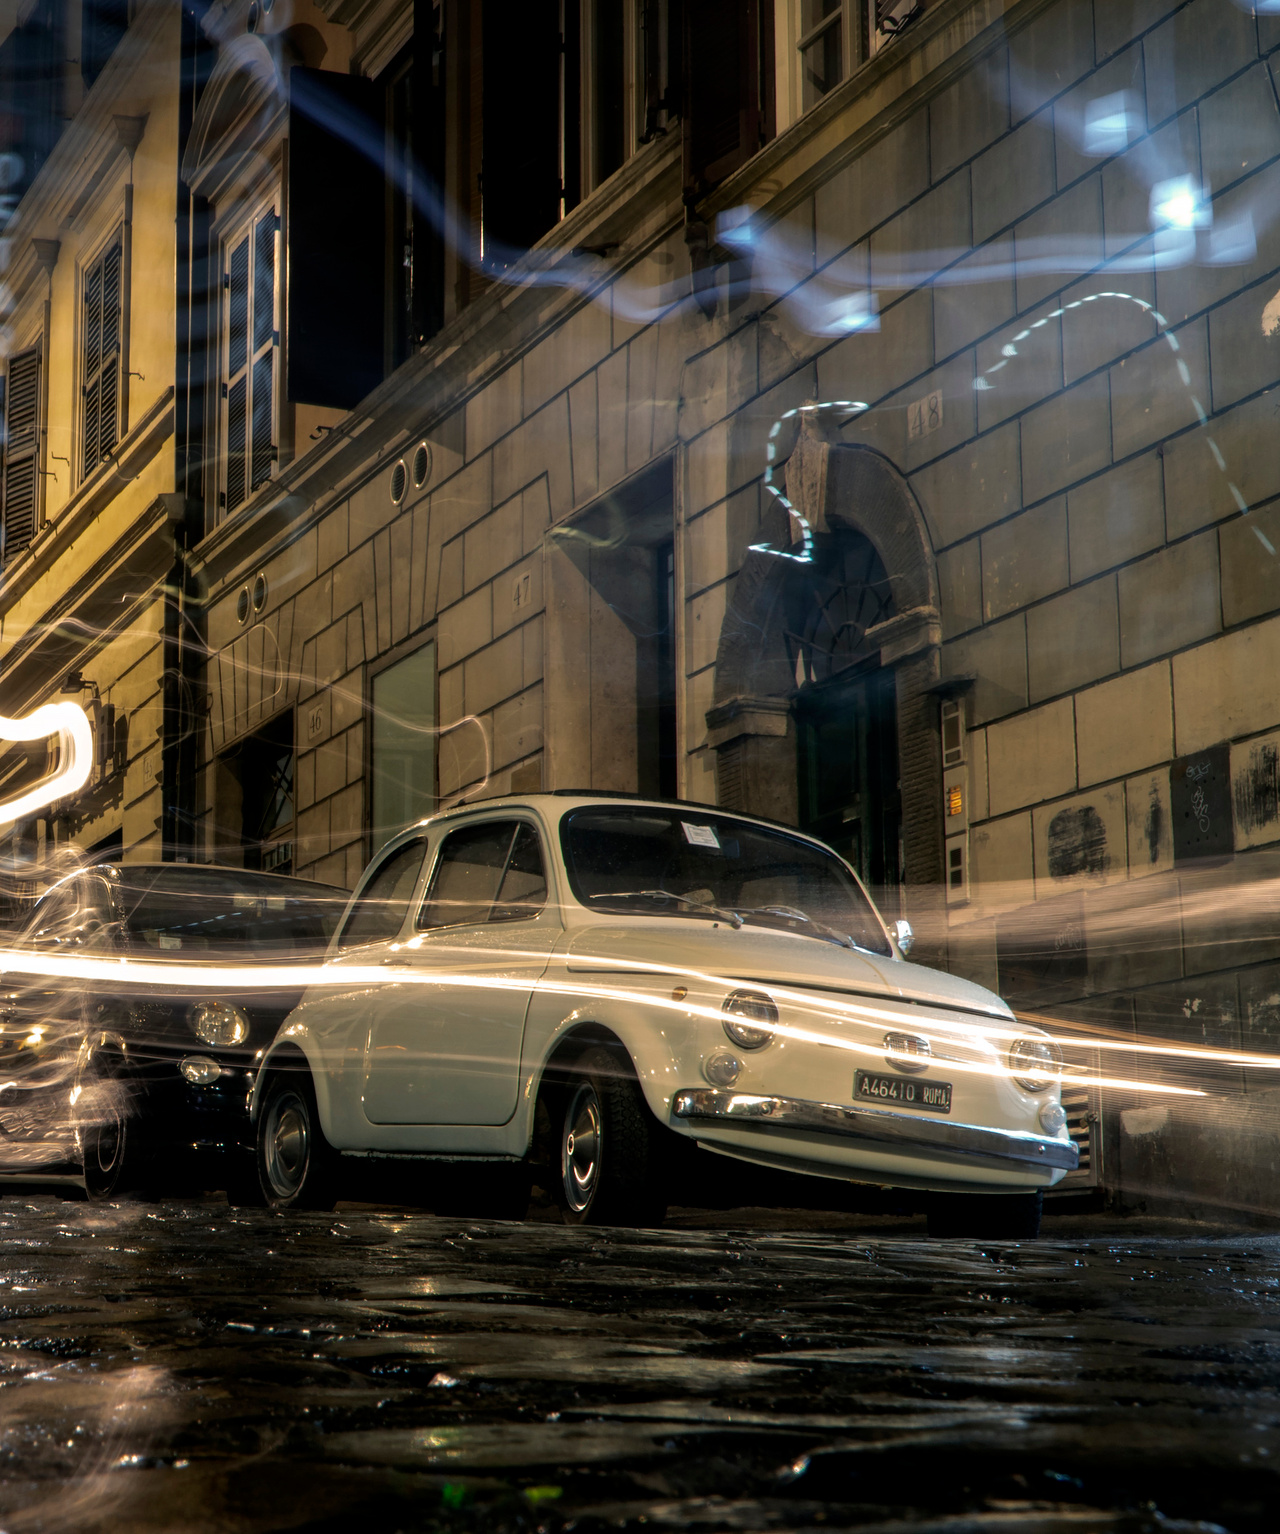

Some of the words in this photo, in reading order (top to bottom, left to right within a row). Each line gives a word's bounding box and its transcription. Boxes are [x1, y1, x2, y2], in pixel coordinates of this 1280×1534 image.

[911, 395, 939, 436] 48
[513, 574, 530, 606] 47
[310, 708, 322, 733] 46
[861, 1076, 915, 1102] A46410
[923, 1086, 947, 1106] ROMA
